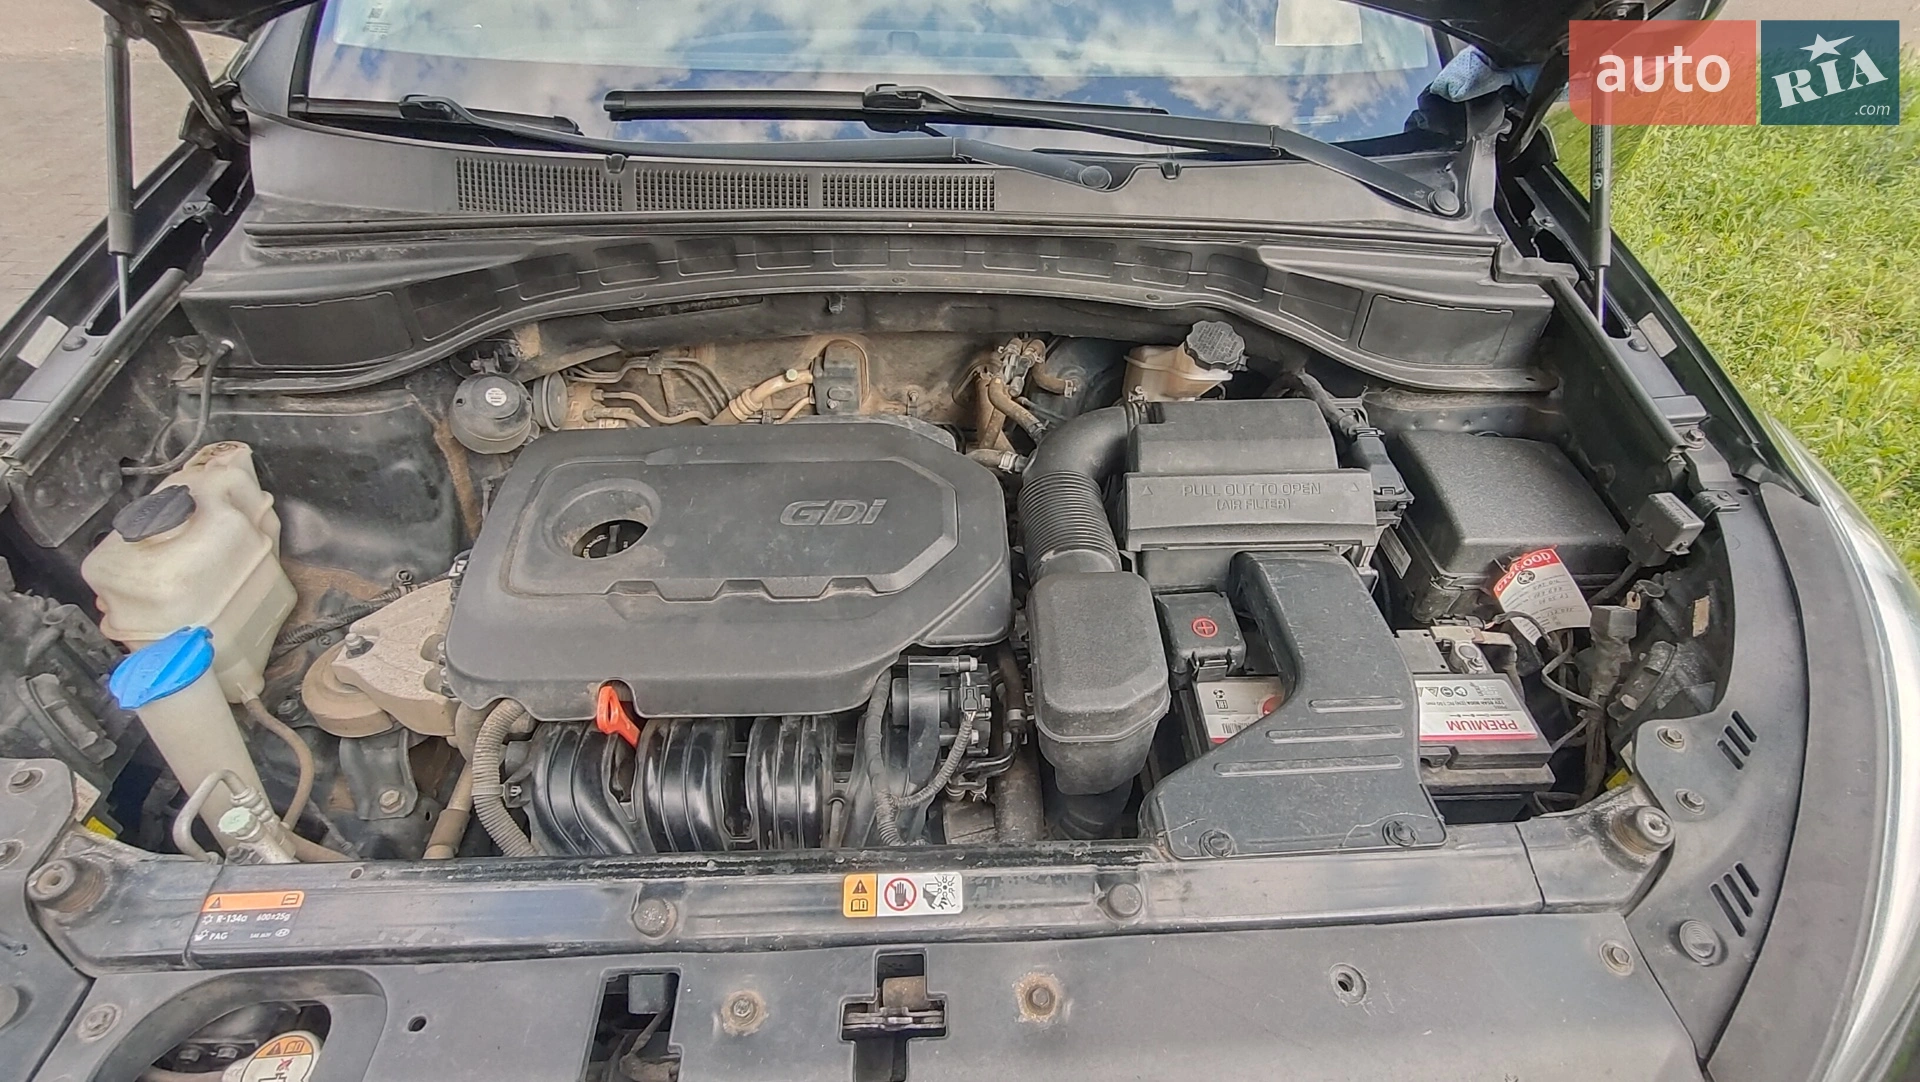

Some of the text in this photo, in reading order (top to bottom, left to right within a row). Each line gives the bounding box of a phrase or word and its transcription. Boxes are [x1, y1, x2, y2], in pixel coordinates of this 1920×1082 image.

[1182, 482, 1321, 497] PULL OUT TO OPEN
[1215, 498, 1291, 511] (AIR FILTER)
[1445, 719, 1519, 731] PREMIUM
[208, 932, 229, 940] PAG
